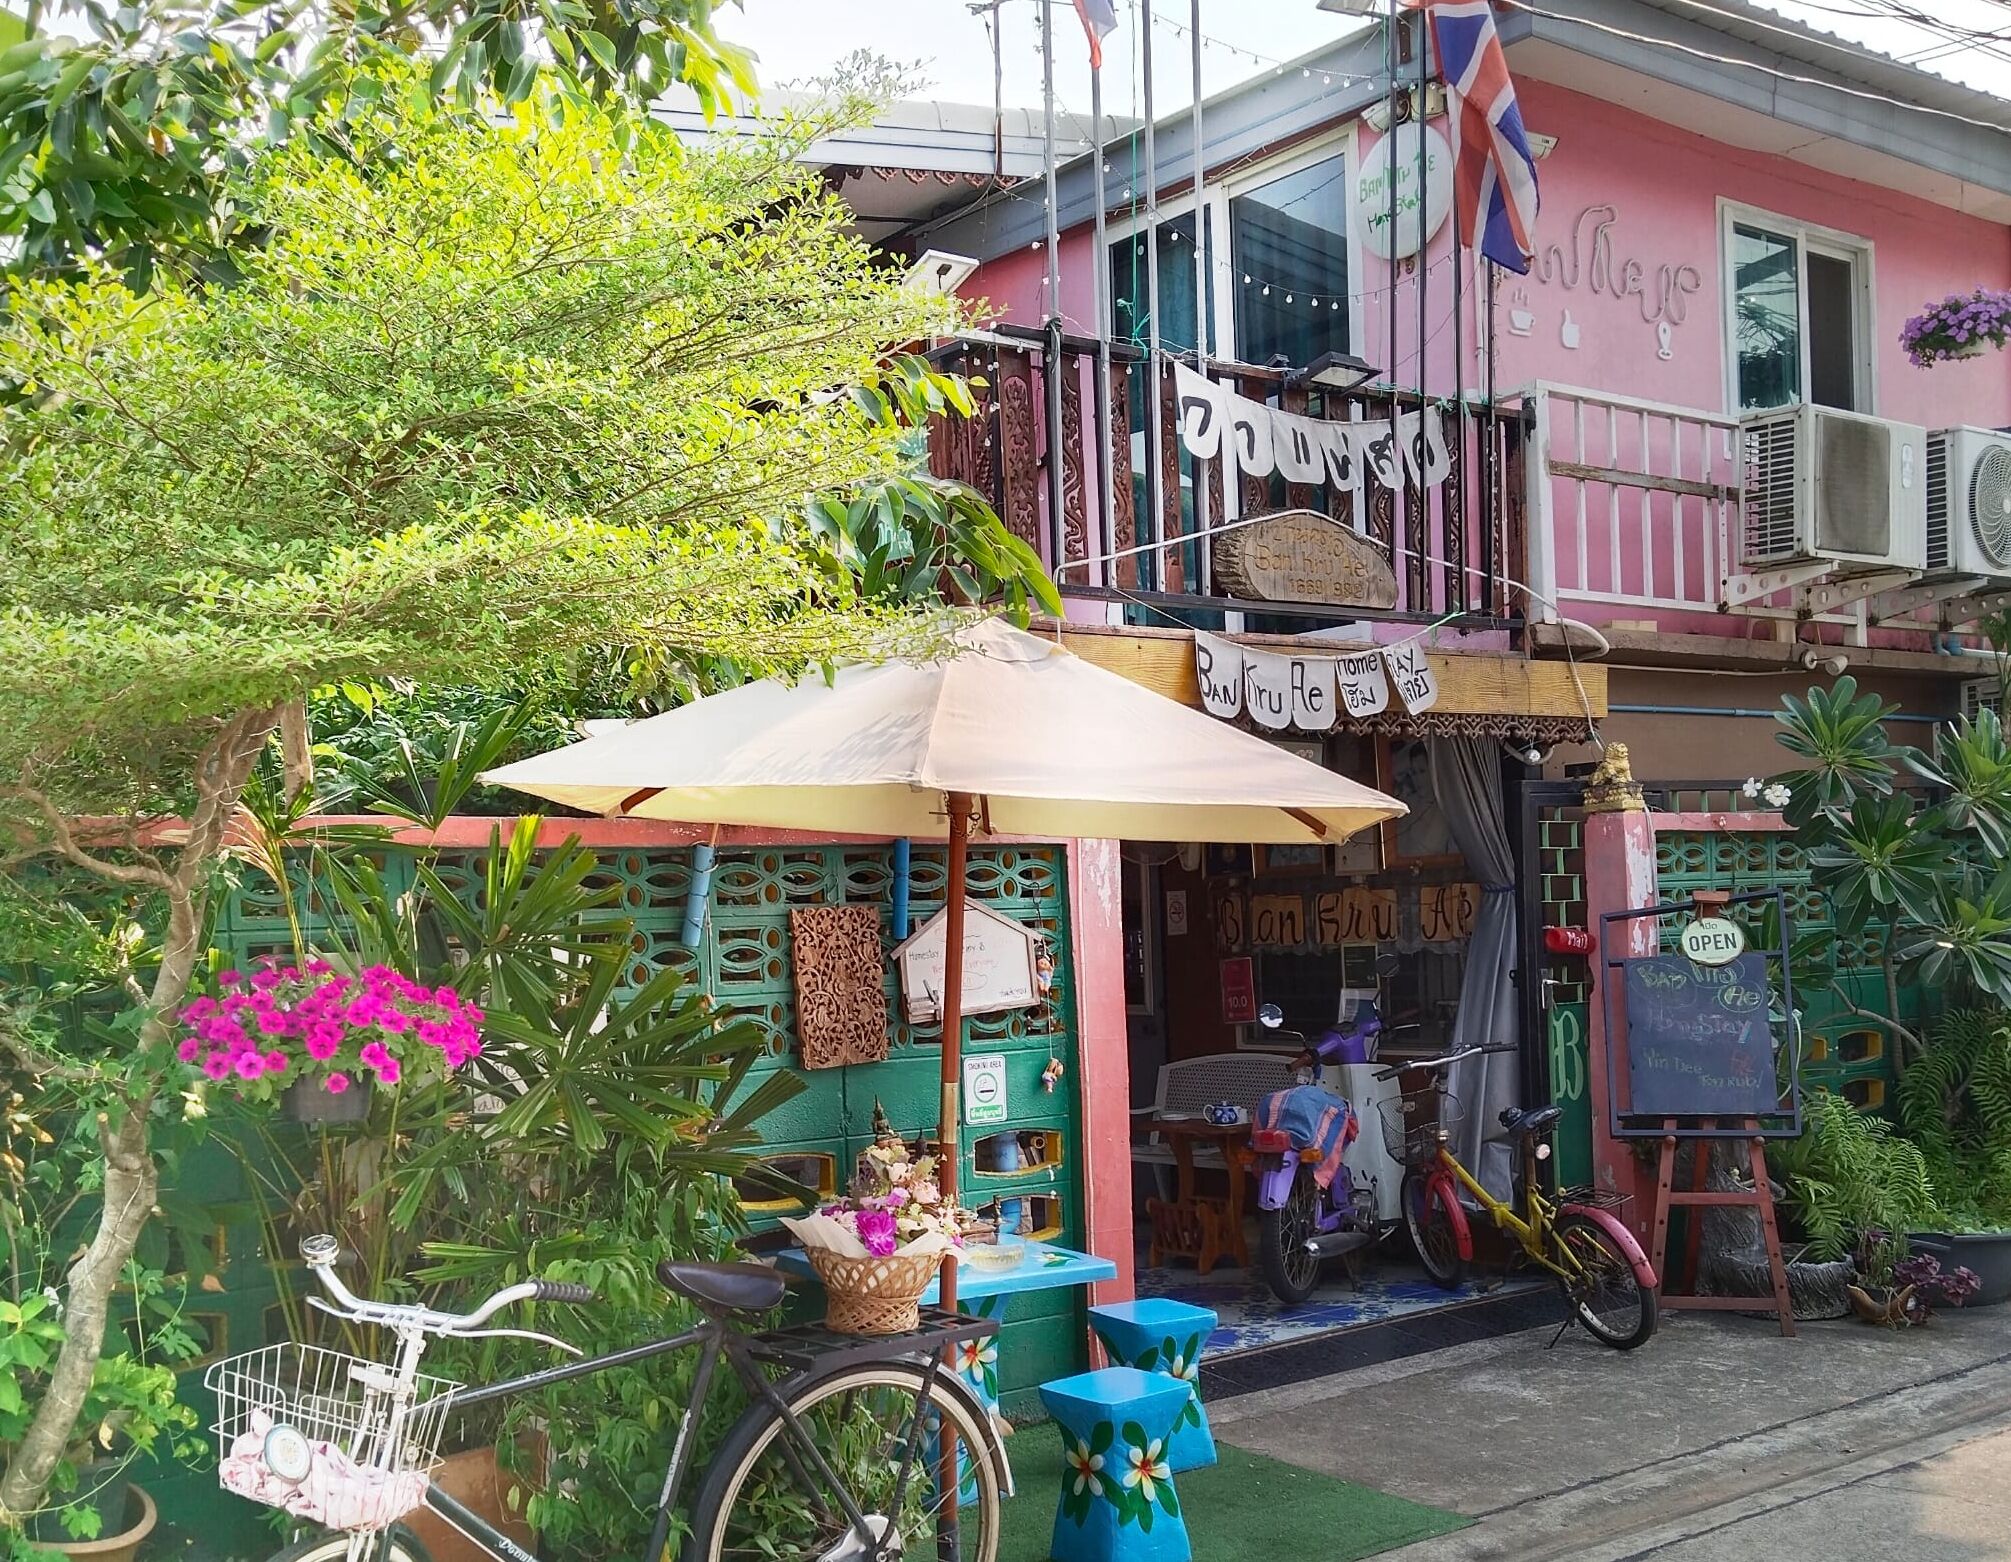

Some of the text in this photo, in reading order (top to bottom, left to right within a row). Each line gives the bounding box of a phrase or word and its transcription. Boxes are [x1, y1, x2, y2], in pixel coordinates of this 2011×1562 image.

[1244, 658, 1283, 714] Kru
[1291, 661, 1324, 713] Ae
[1337, 653, 1378, 676] Home
[1566, 931, 1588, 950] Mail
[1689, 932, 1737, 952] OPEN
[1227, 995, 1248, 1009] 10.0
